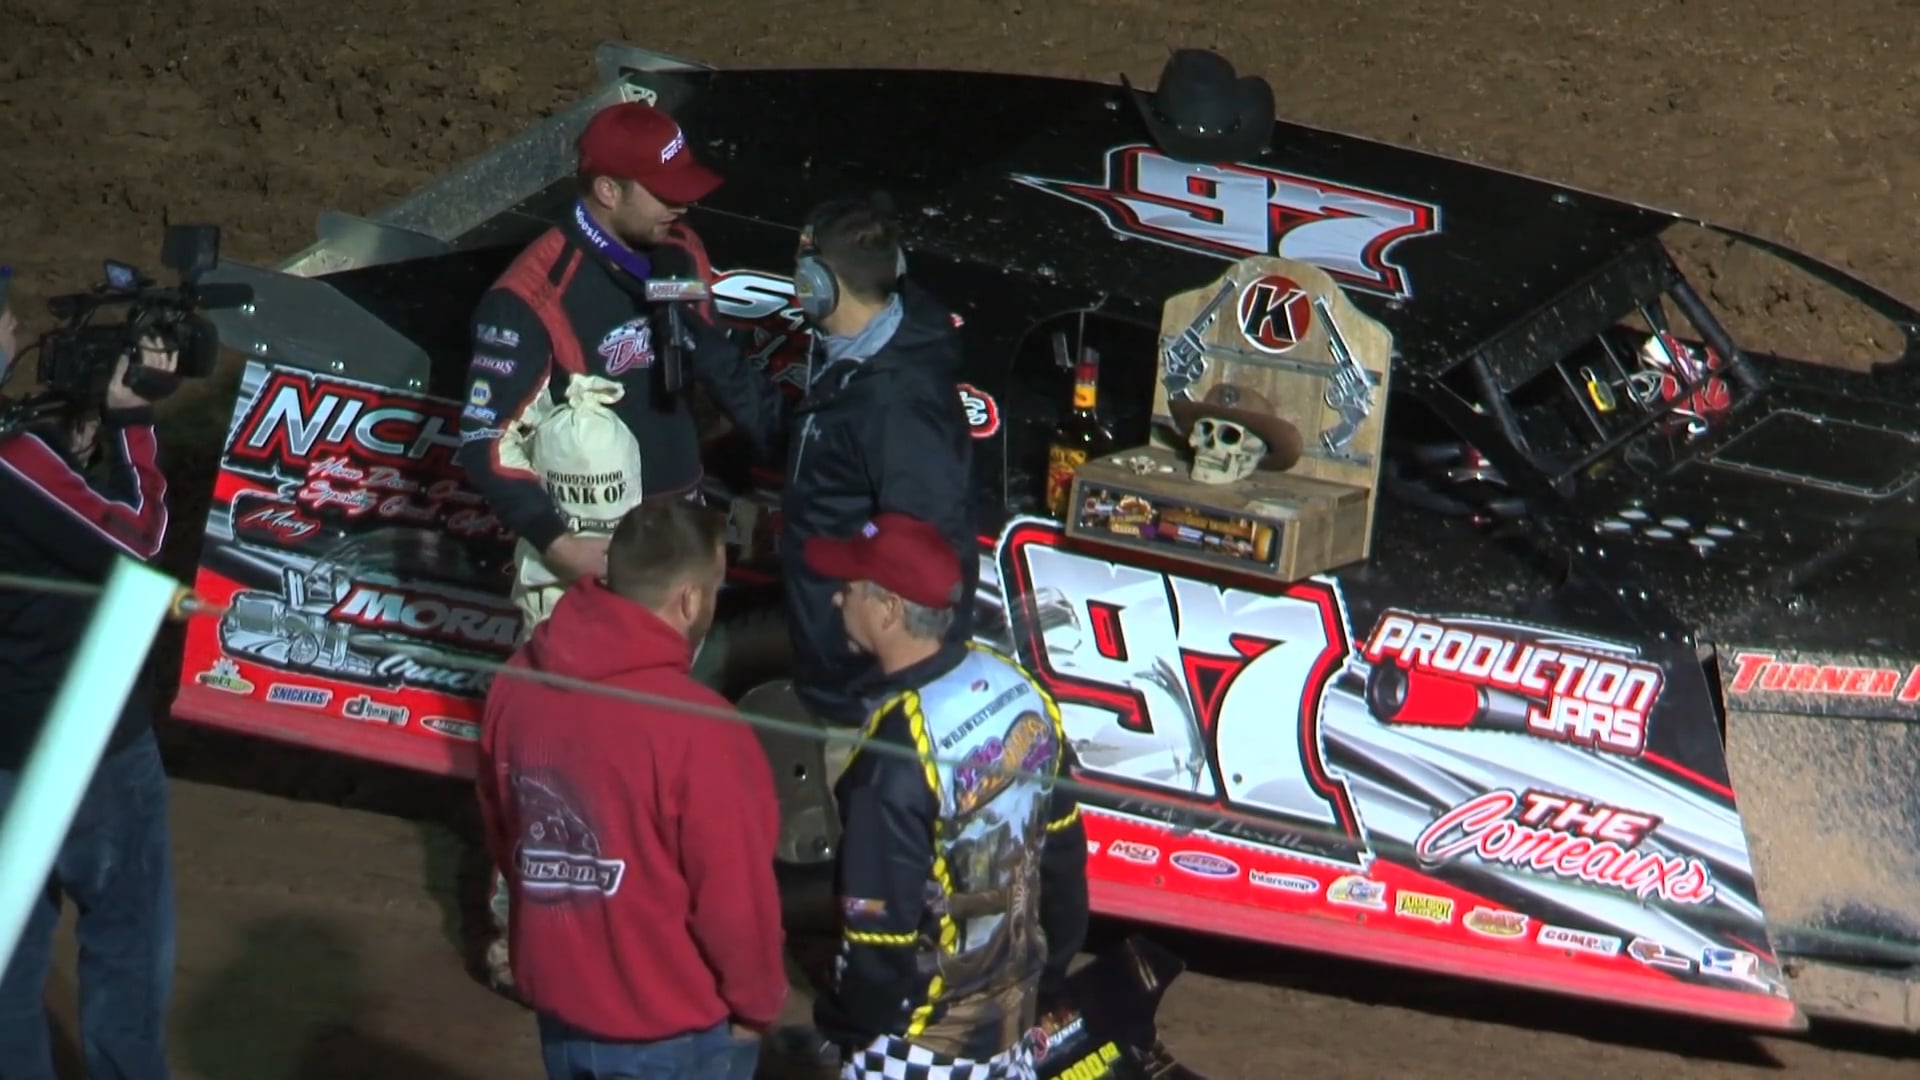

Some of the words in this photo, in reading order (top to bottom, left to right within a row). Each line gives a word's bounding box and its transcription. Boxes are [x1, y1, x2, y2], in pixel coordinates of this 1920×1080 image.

[1113, 150, 1425, 287] 97
[1243, 283, 1306, 343] K
[1018, 543, 1338, 824] 97
[1370, 617, 1659, 711] PRODUCTION
[271, 687, 327, 704] SNICKERS
[1528, 694, 1644, 749] JARS
[1517, 794, 1655, 840] THE
[1112, 843, 1157, 858] MSD
[1251, 871, 1312, 891] Intercomp
